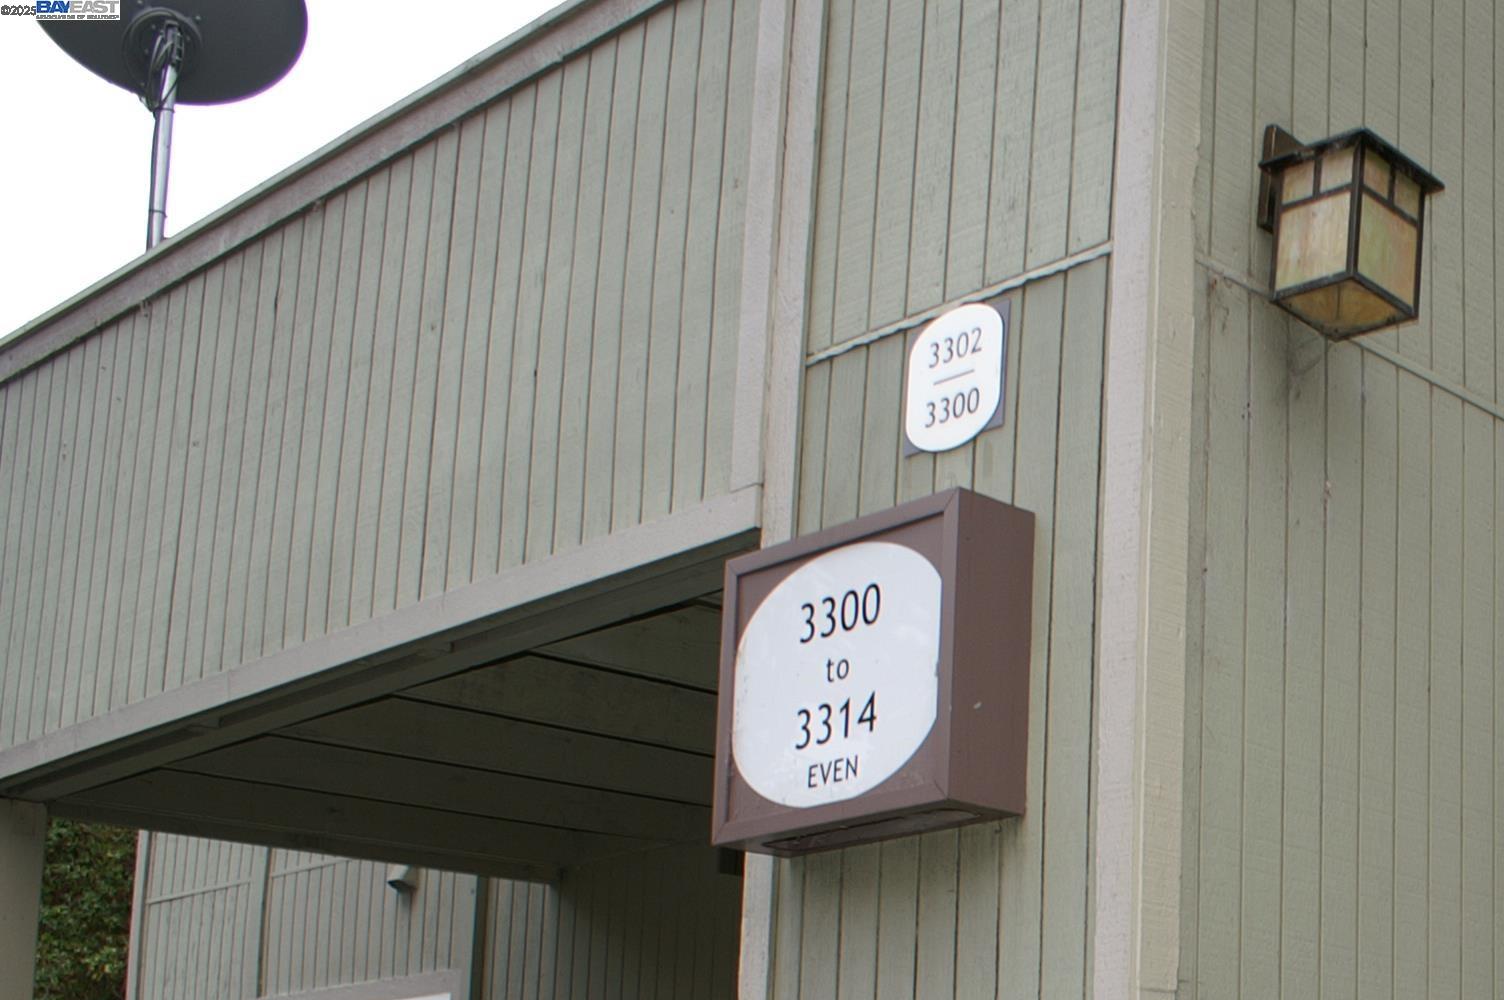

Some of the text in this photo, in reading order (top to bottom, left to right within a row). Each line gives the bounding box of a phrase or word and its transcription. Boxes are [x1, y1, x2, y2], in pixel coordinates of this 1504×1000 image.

[927, 326, 983, 370] 3302
[924, 386, 981, 429] 3300
[799, 583, 881, 644] 3300
[826, 658, 850, 683] to
[795, 691, 877, 750] 3314
[807, 755, 859, 789] EVEN
